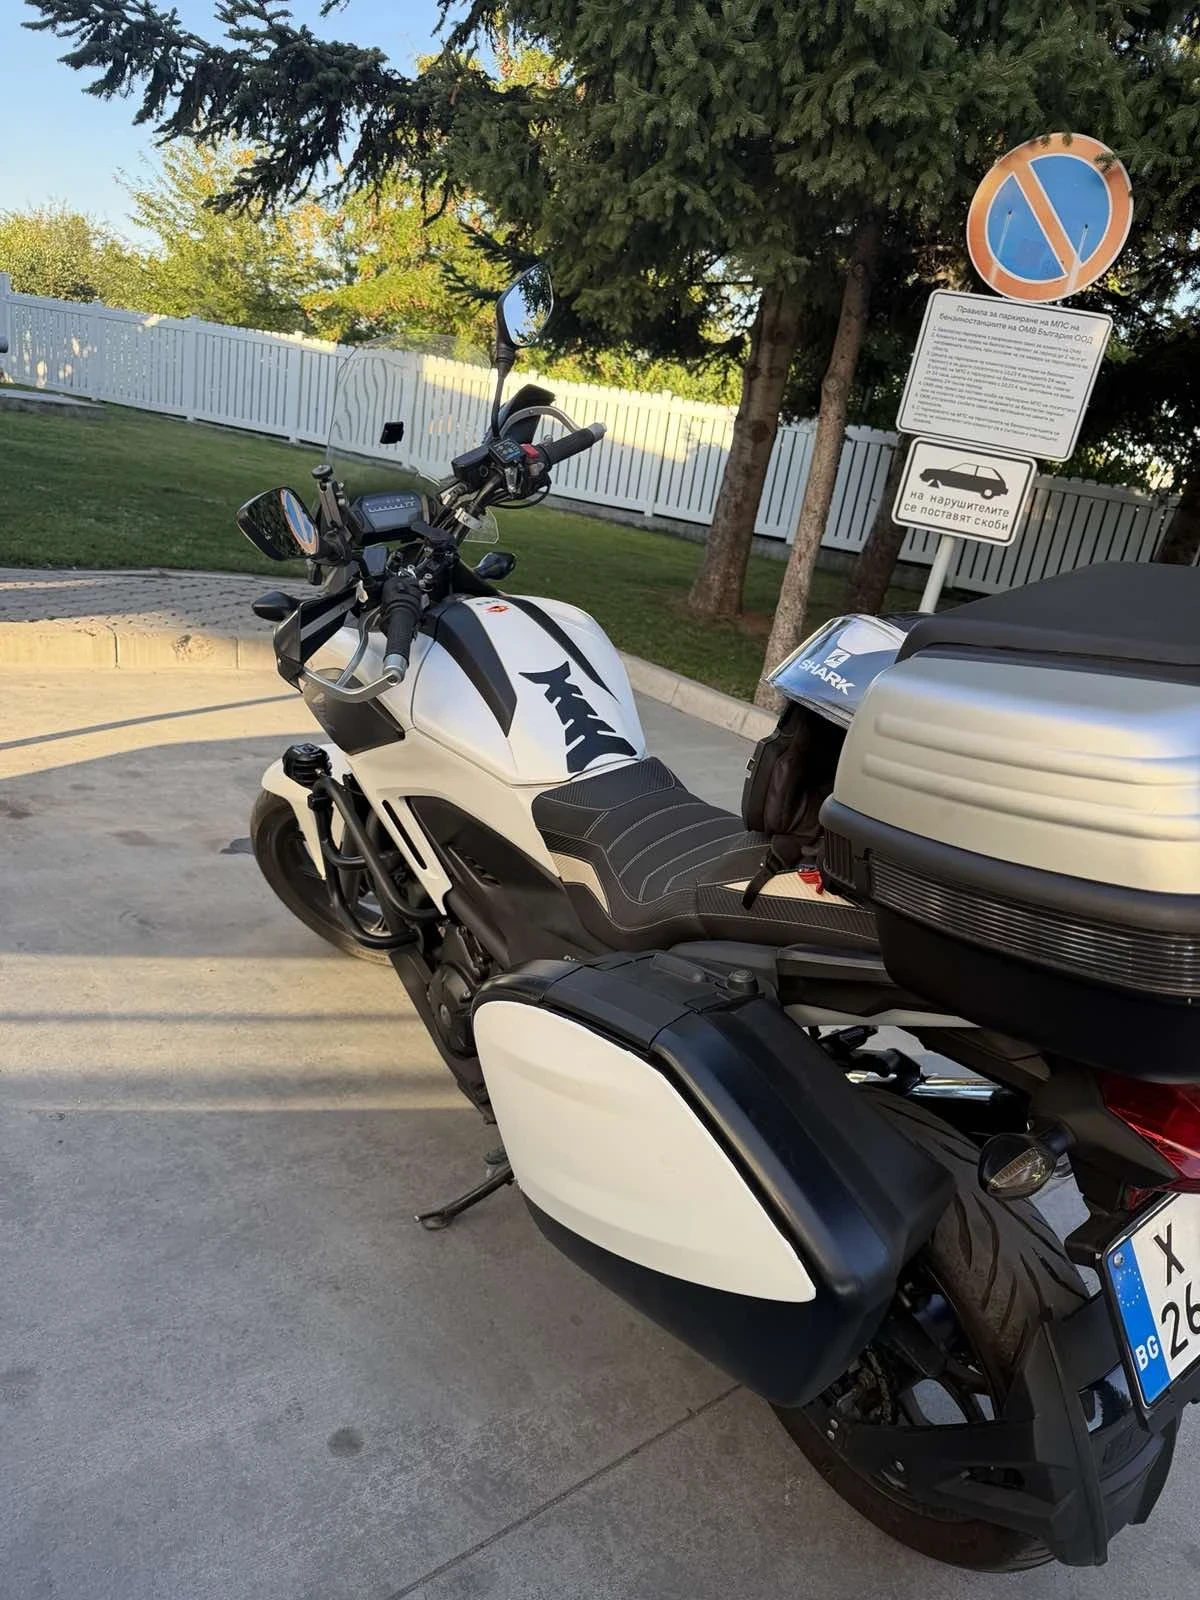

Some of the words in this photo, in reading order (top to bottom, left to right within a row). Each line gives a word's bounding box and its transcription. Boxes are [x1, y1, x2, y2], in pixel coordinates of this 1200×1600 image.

[956, 304, 989, 317] Правила
[999, 312, 1039, 325] паркиране
[1050, 318, 1070, 330] МПС
[1070, 323, 1080, 331] на
[1008, 324, 1017, 332] на
[1038, 328, 1073, 341] България
[1074, 334, 1094, 345] ООД
[903, 503, 917, 512] се
[920, 506, 972, 522] поставят
[974, 517, 1009, 531] скоби
[910, 490, 924, 500] на
[930, 495, 1010, 518] нарушителите
[799, 659, 856, 696] SHARK
[1135, 1335, 1160, 1372] BG
